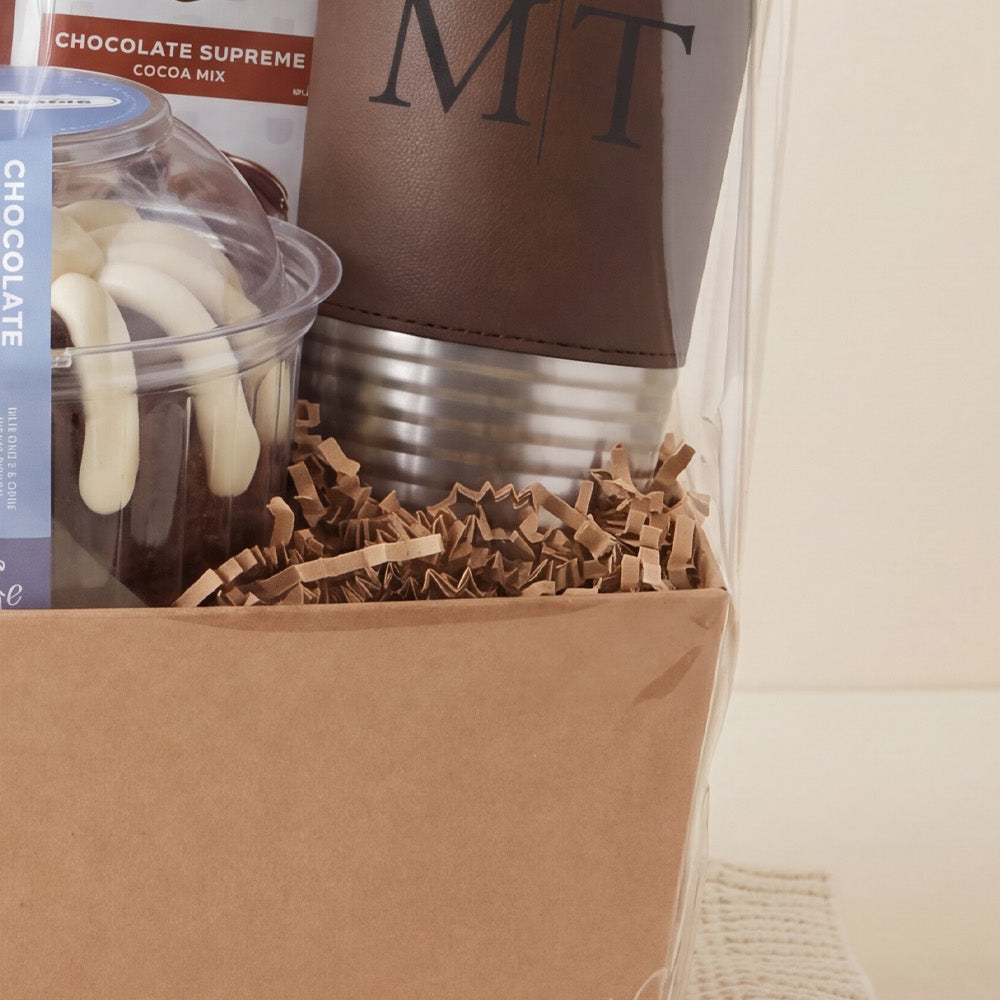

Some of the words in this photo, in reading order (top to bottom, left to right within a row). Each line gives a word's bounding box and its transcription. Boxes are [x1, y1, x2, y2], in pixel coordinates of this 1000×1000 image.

[55, 31, 193, 60] CHOCOLATE
[200, 44, 307, 69] SUPREME
[133, 63, 192, 80] COCOA
[196, 68, 226, 83] MIX
[2, 159, 26, 347] CHOCOLATE
